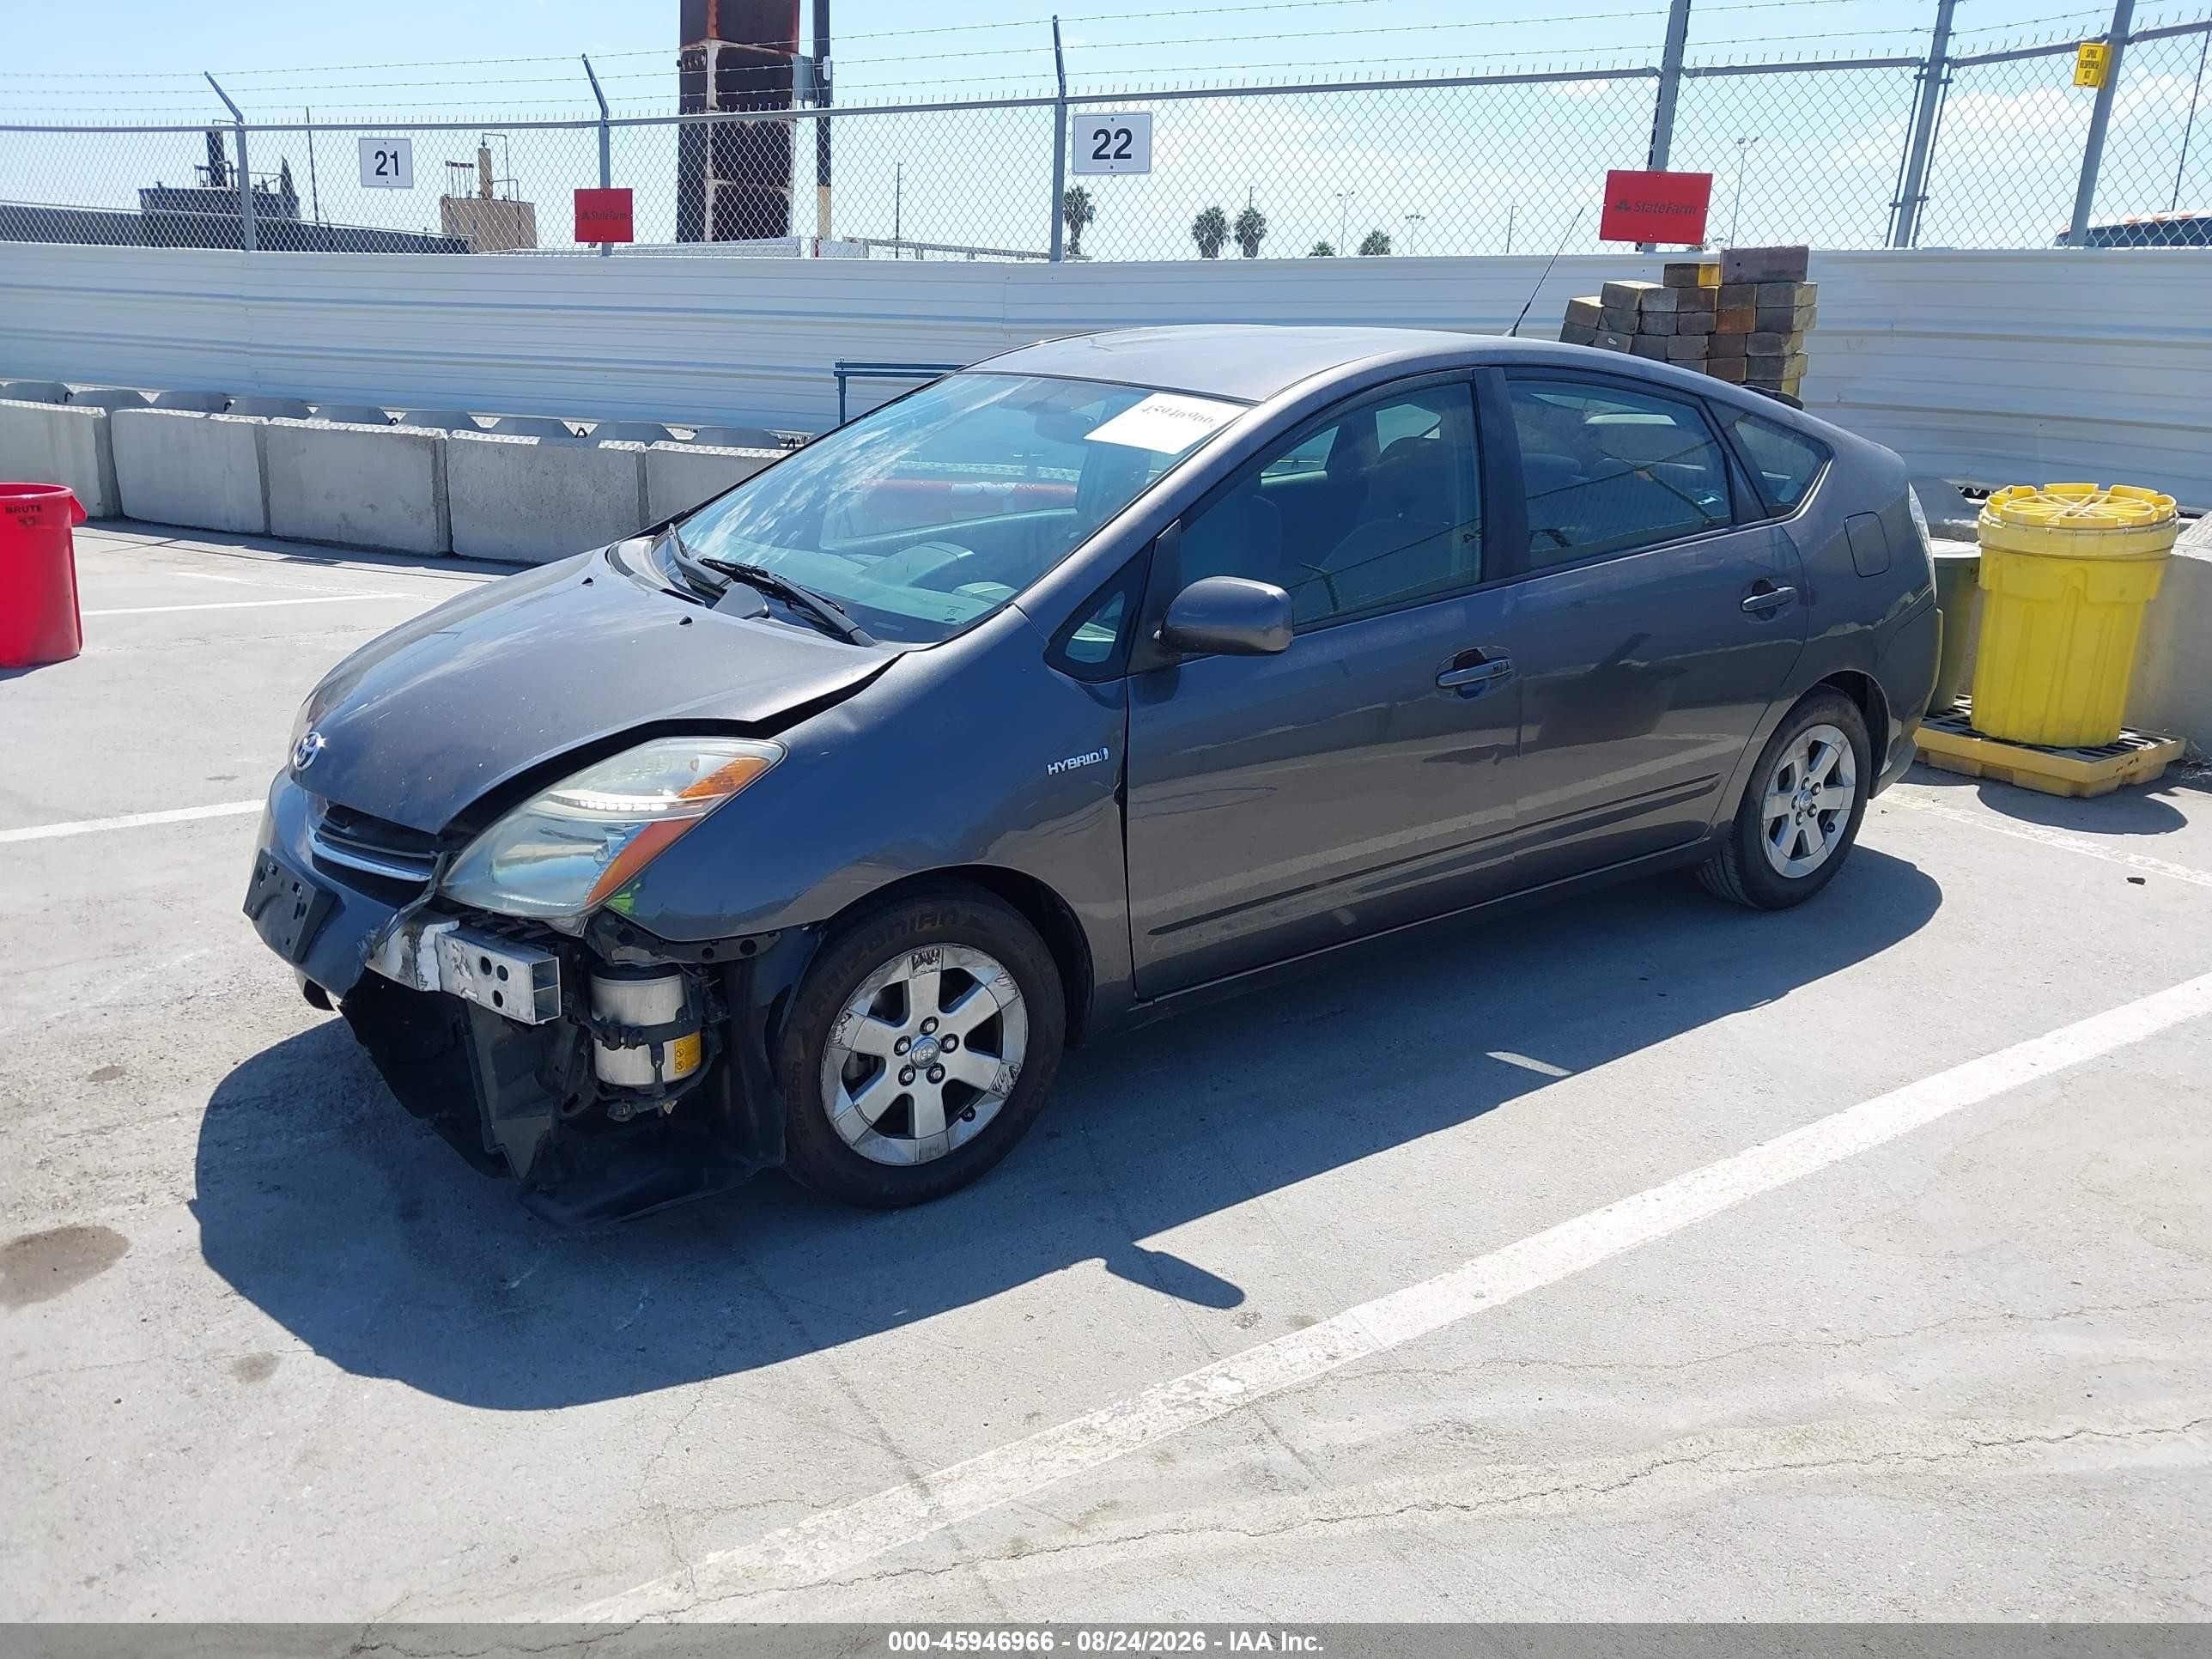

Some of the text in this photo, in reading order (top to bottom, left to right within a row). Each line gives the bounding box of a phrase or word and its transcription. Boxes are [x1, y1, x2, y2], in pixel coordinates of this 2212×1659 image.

[1091, 128, 1133, 160] 22
[374, 150, 399, 176] 21
[1047, 751, 1100, 775] HYBRID
